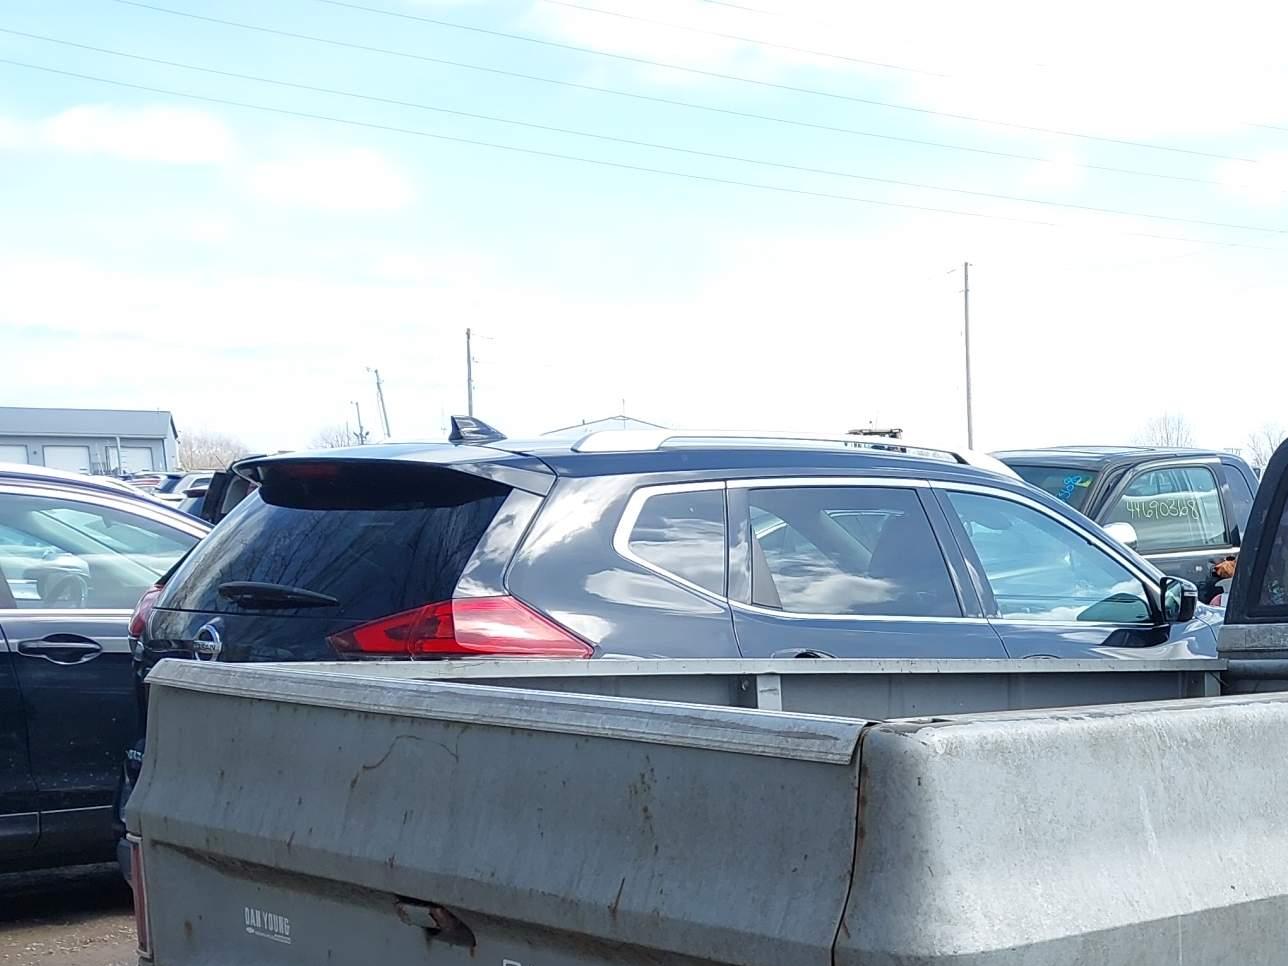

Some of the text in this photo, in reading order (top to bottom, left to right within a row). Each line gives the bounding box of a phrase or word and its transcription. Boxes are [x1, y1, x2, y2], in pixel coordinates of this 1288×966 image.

[1125, 499, 1200, 520] 44690368
[244, 907, 262, 928] DAN
[262, 911, 290, 936] YOUNG
